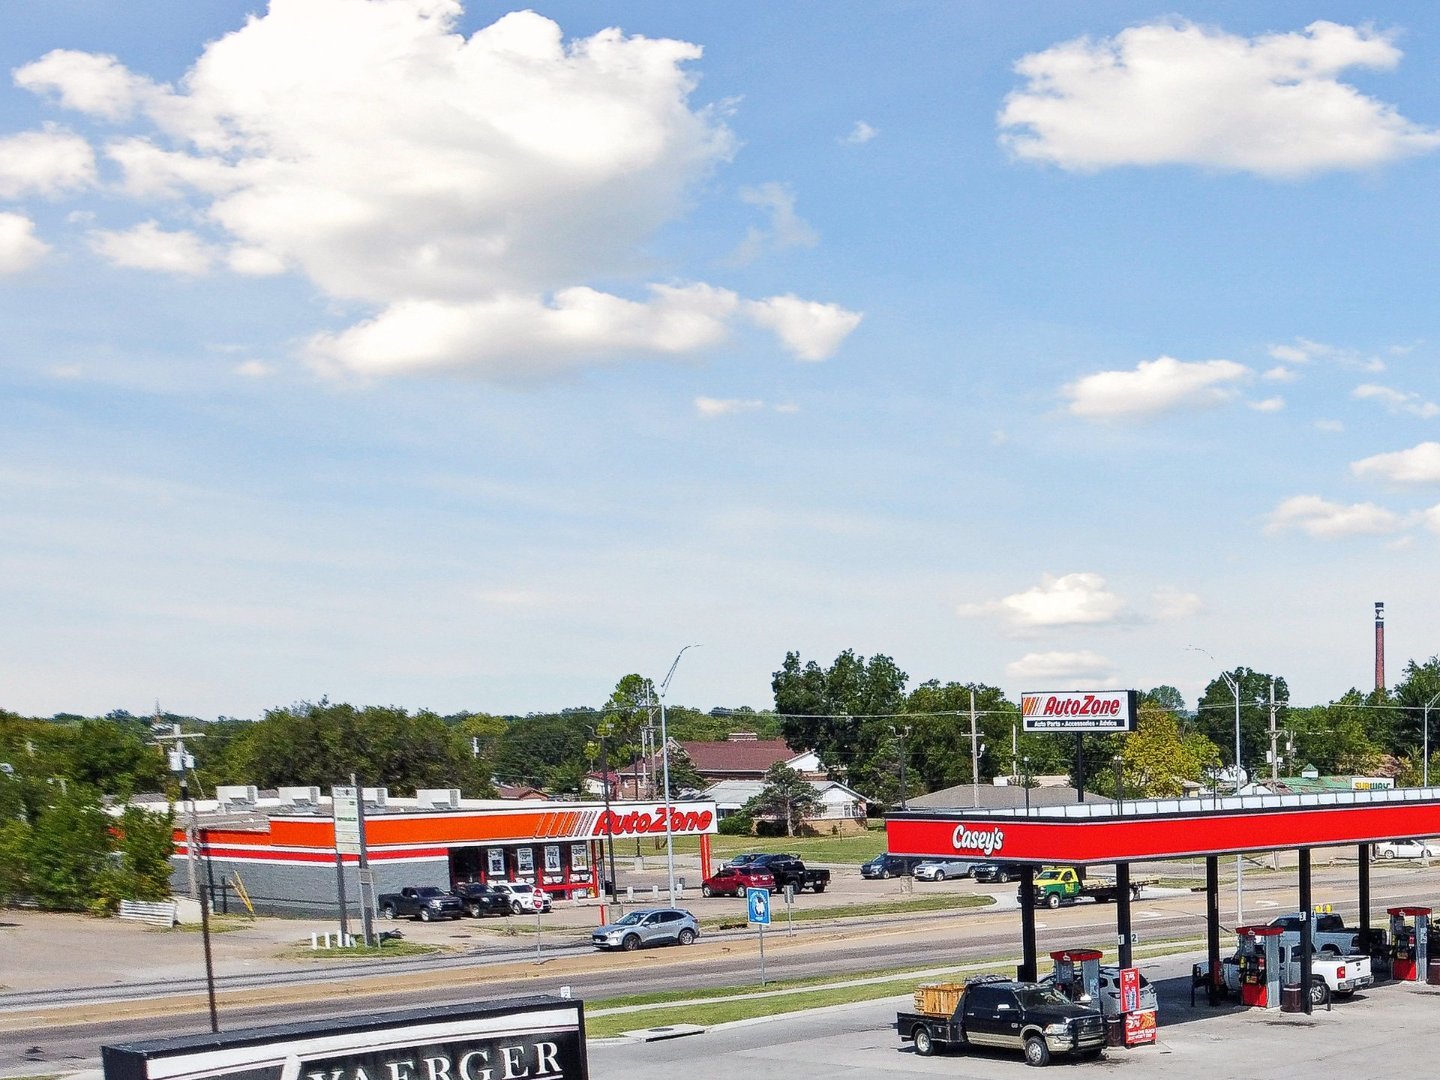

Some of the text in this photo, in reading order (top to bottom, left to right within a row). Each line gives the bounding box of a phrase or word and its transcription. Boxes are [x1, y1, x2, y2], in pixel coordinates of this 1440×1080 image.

[1043, 695, 1121, 716] AutoZone
[592, 806, 713, 835] AutoZone
[952, 824, 1005, 856] Casey's
[1131, 933, 1138, 942] 2
